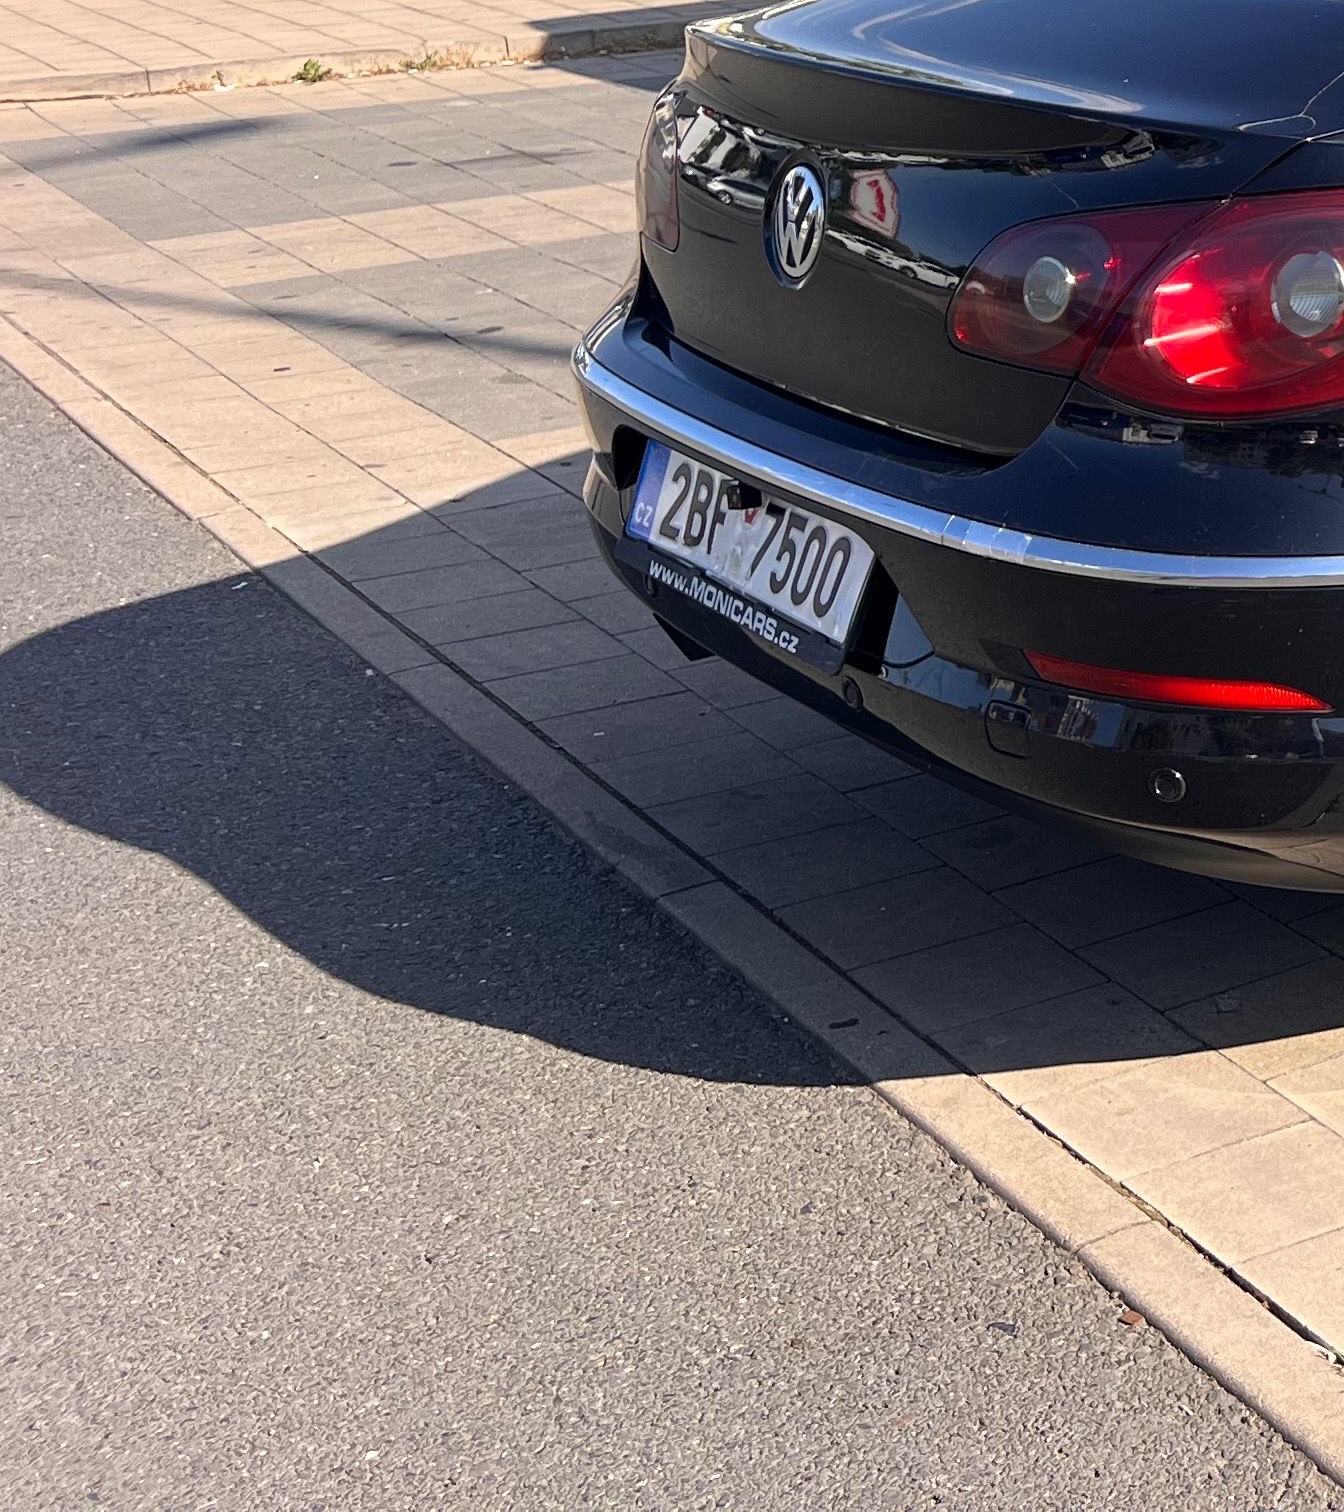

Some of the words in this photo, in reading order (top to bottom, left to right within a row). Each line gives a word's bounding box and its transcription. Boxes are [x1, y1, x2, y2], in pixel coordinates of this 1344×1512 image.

[634, 501, 654, 528] CZ
[749, 503, 851, 618] 7500
[649, 559, 800, 654] www.MONICARS.cz
